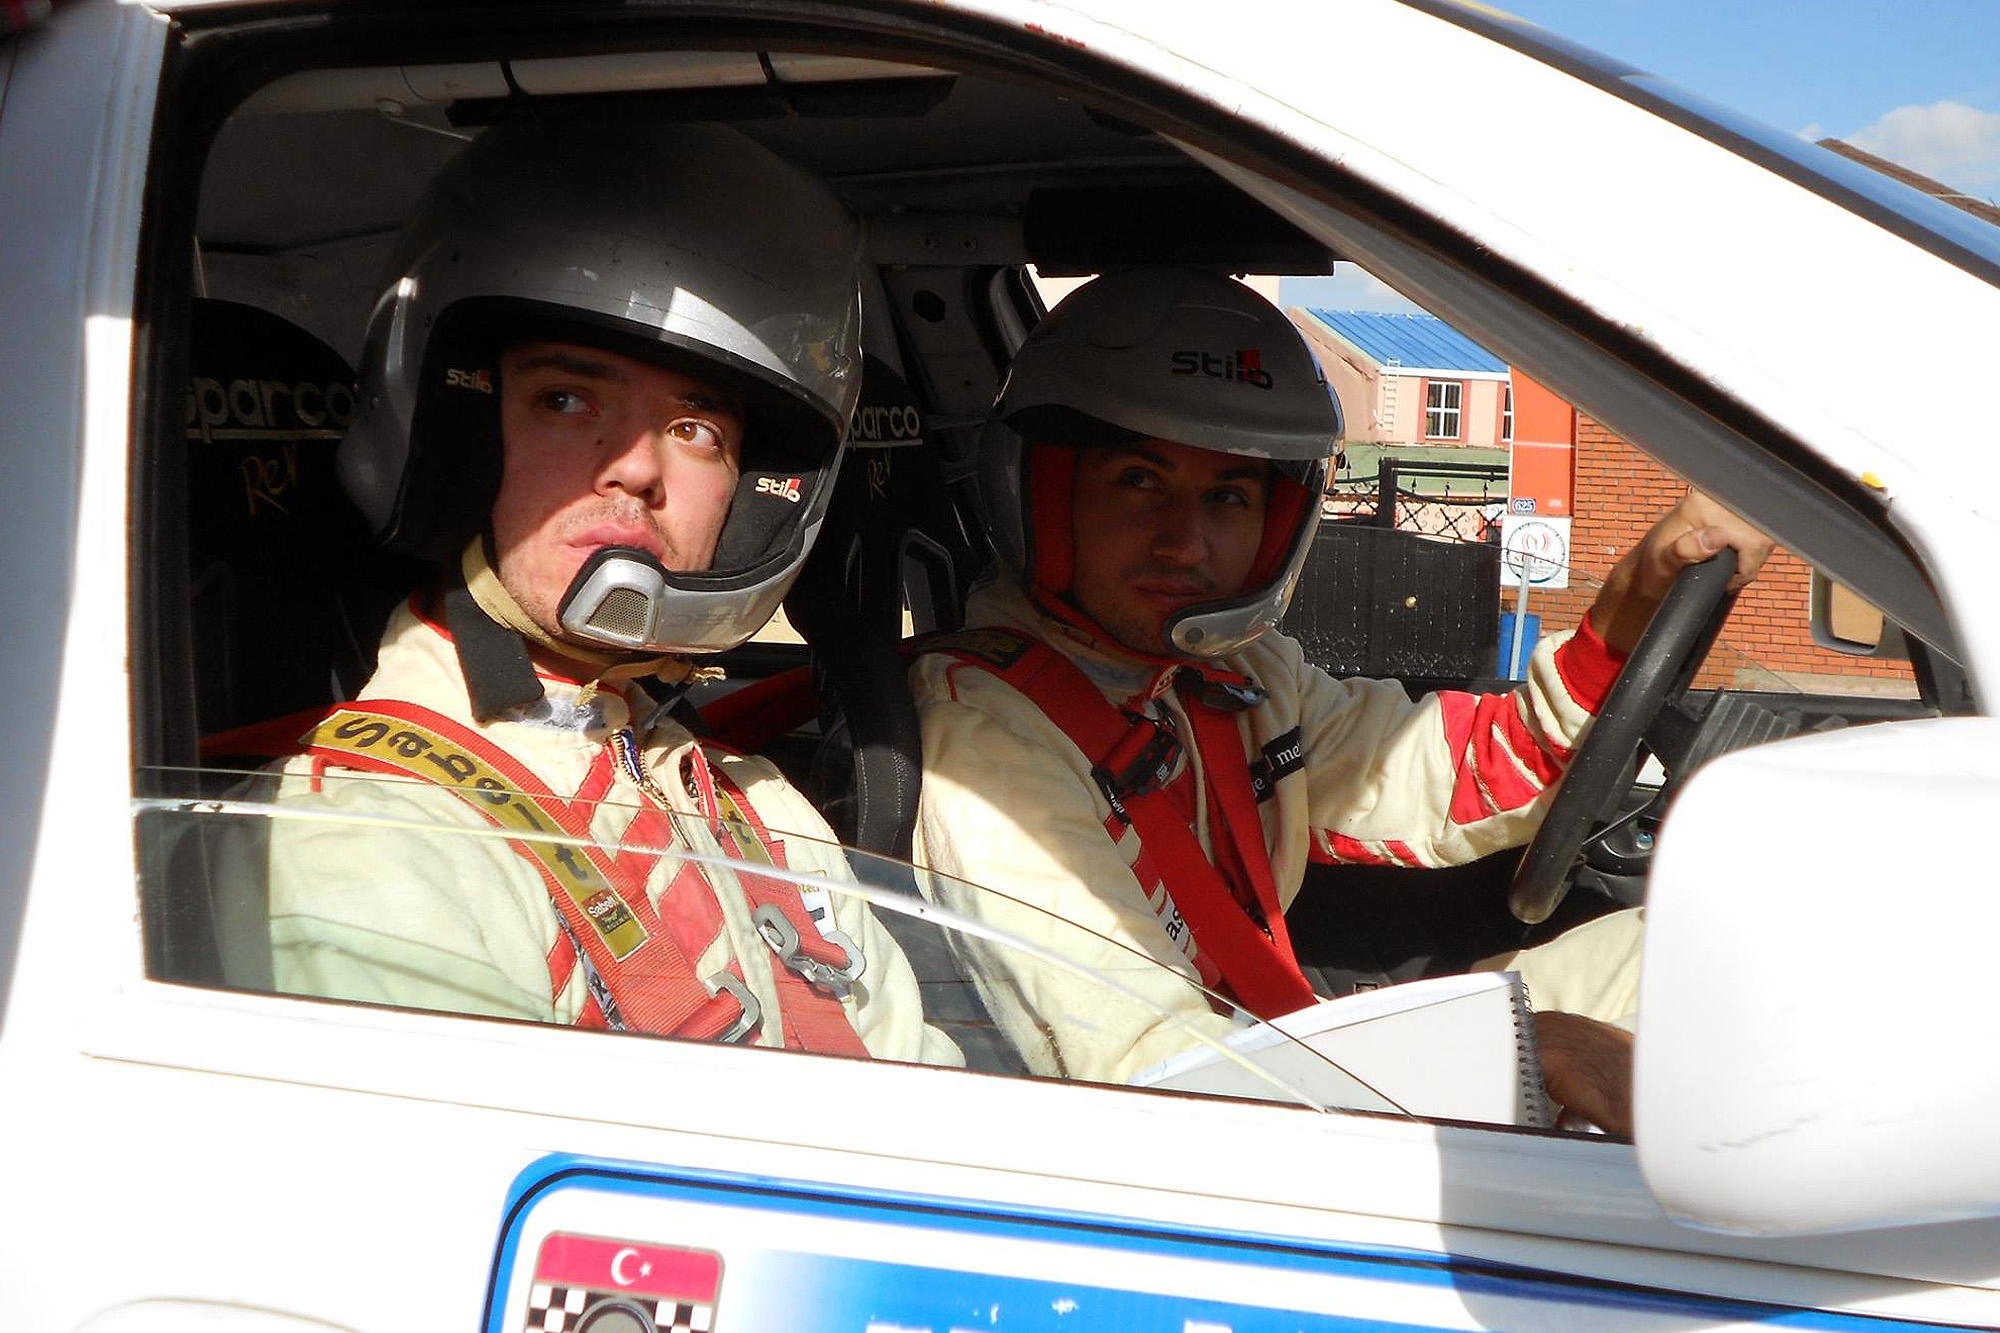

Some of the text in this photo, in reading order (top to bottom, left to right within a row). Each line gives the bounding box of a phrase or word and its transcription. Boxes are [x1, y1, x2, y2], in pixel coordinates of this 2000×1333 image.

[1171, 349, 1273, 391] Stilo
[851, 405, 920, 450] parco
[755, 477, 801, 503] Stilo
[1514, 499, 1534, 512] 625
[334, 717, 588, 880] Sabelt
